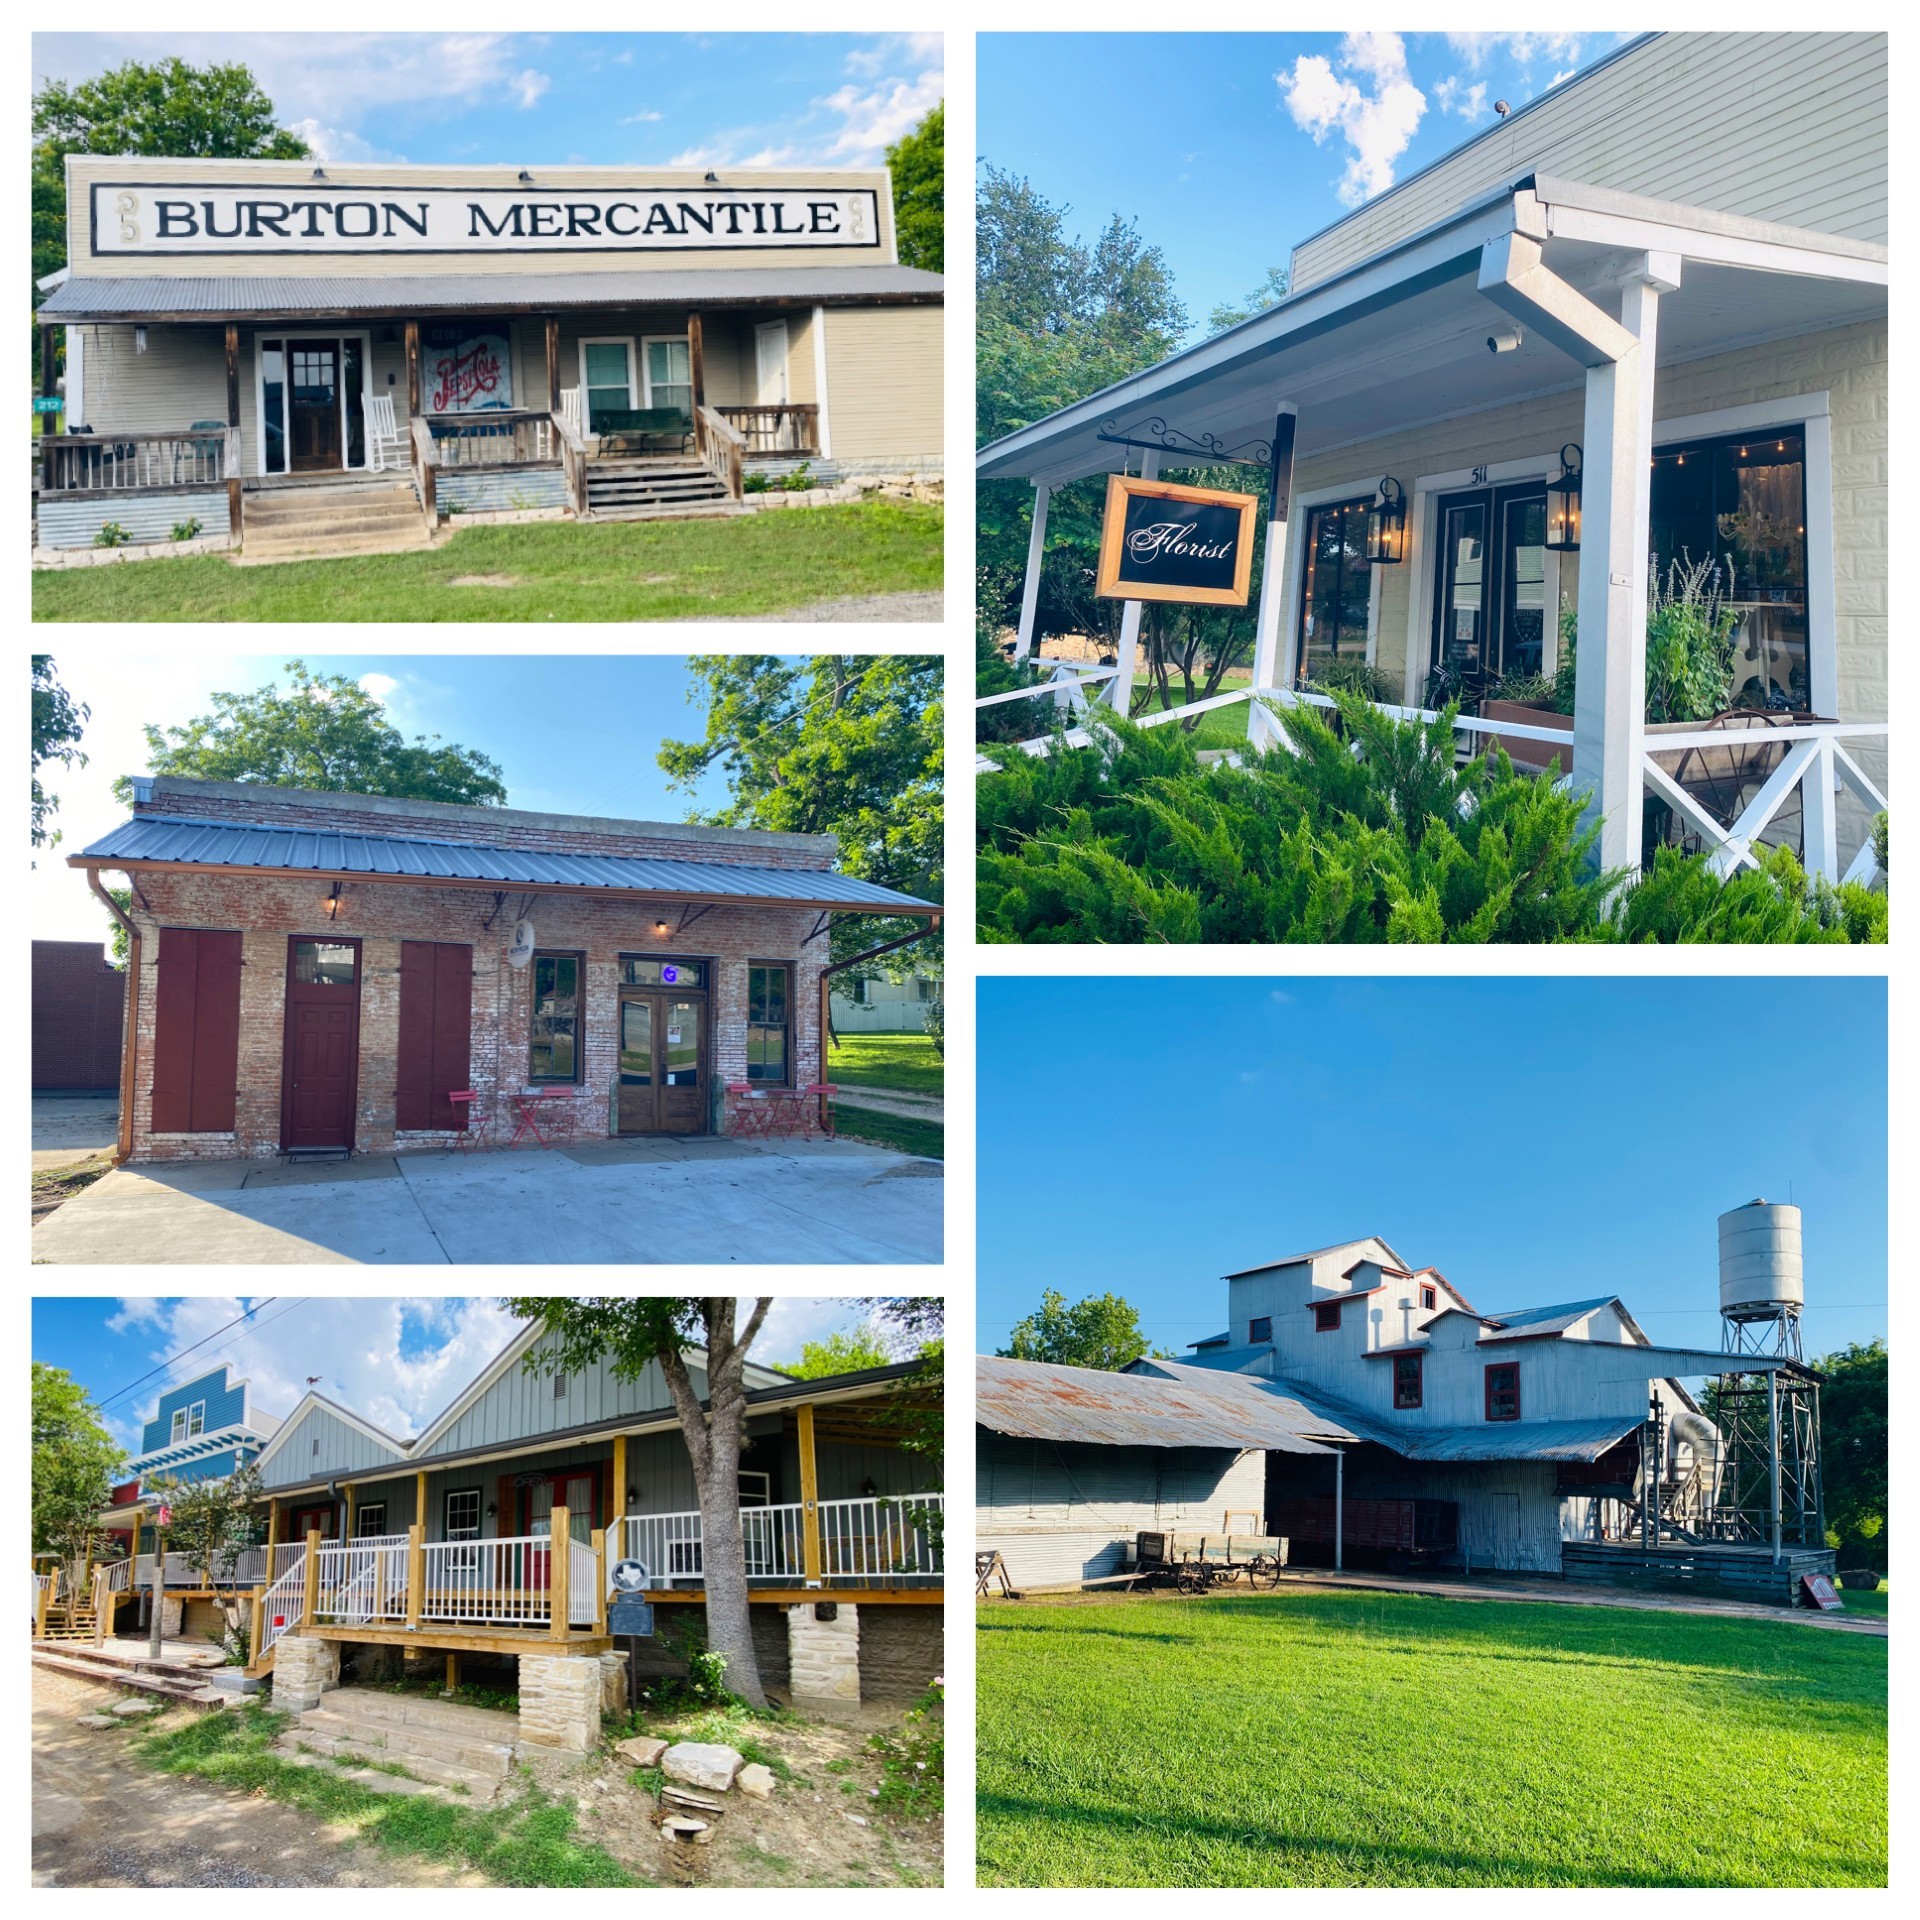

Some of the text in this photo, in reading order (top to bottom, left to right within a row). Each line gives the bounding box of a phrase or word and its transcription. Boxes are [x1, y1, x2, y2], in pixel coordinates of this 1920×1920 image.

[154, 200, 841, 238] BURTON MERCANTILE
[39, 400, 58, 410] 212
[1471, 465, 1487, 484] 511
[1126, 522, 1233, 564] Florist
[512, 1476, 548, 1488] OPEN
